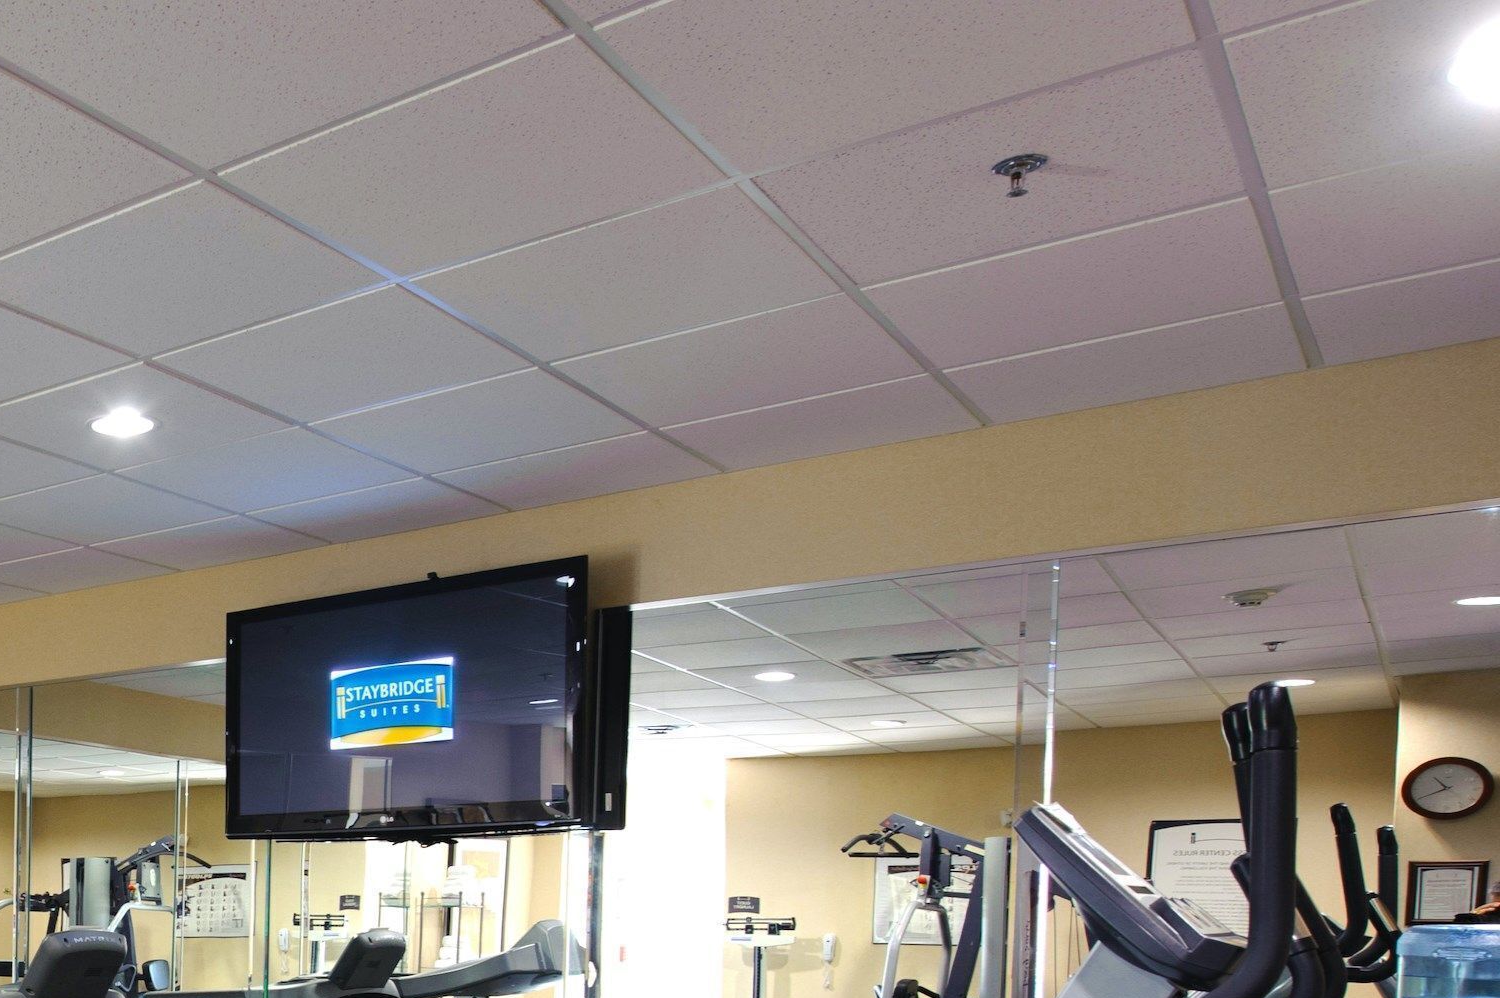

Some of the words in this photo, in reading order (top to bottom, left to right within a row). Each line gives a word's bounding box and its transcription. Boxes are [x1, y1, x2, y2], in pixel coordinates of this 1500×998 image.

[345, 678, 434, 702] STAYBRIDGE
[359, 704, 421, 719] SUITES
[73, 935, 116, 944] MATRIX
